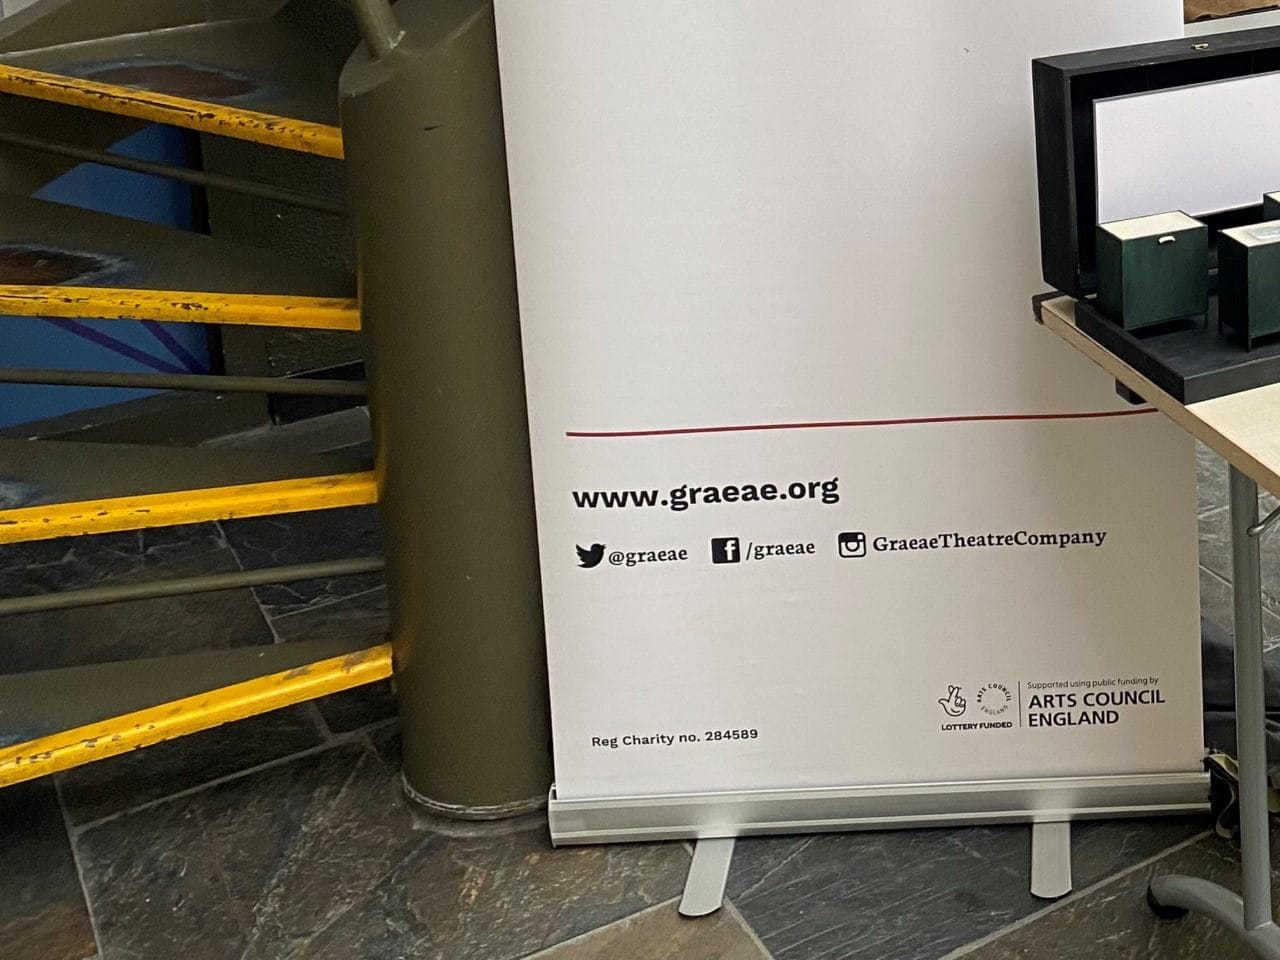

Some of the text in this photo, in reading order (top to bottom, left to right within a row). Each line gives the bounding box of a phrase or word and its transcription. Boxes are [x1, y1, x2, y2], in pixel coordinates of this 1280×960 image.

[572, 477, 840, 511] www.graeae.org
[608, 528, 1107, 567] @graeae /graeae GraeaeTheatreCompany
[1027, 676, 1159, 691] Supported using public funding by
[1028, 689, 1166, 709] ARTS COUNCIL
[941, 721, 1013, 731] LOTTERY FUNDED
[1028, 710, 1119, 727] ENGLAND
[591, 727, 759, 749] Reg Charity no. 284589
